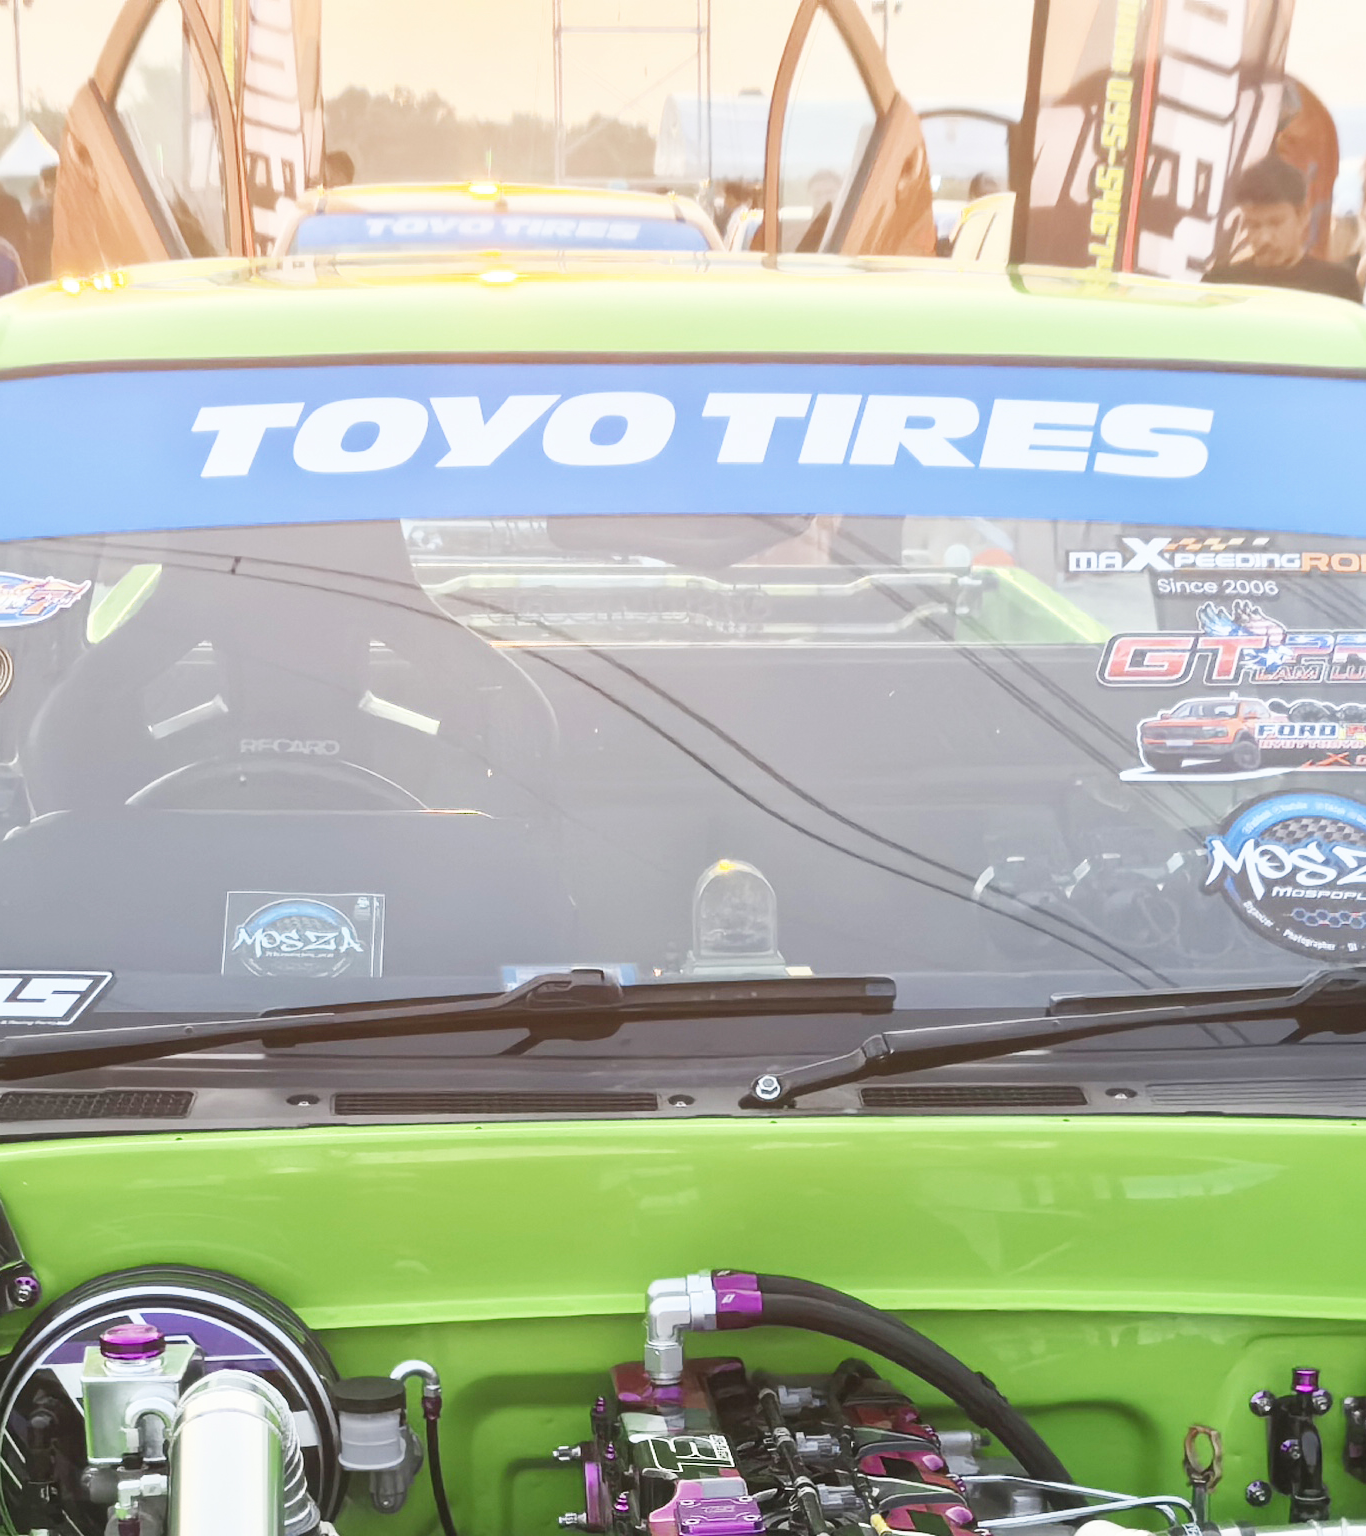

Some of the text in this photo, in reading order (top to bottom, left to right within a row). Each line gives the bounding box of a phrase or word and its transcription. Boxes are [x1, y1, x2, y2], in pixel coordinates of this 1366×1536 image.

[366, 217, 641, 240] TOYO TIRES
[191, 391, 1214, 479] TOYO TIRES
[1157, 578, 1279, 596] Since 2006
[1105, 635, 1269, 682] GT
[1256, 724, 1338, 739] FORD
[231, 926, 365, 959] MOSZA
